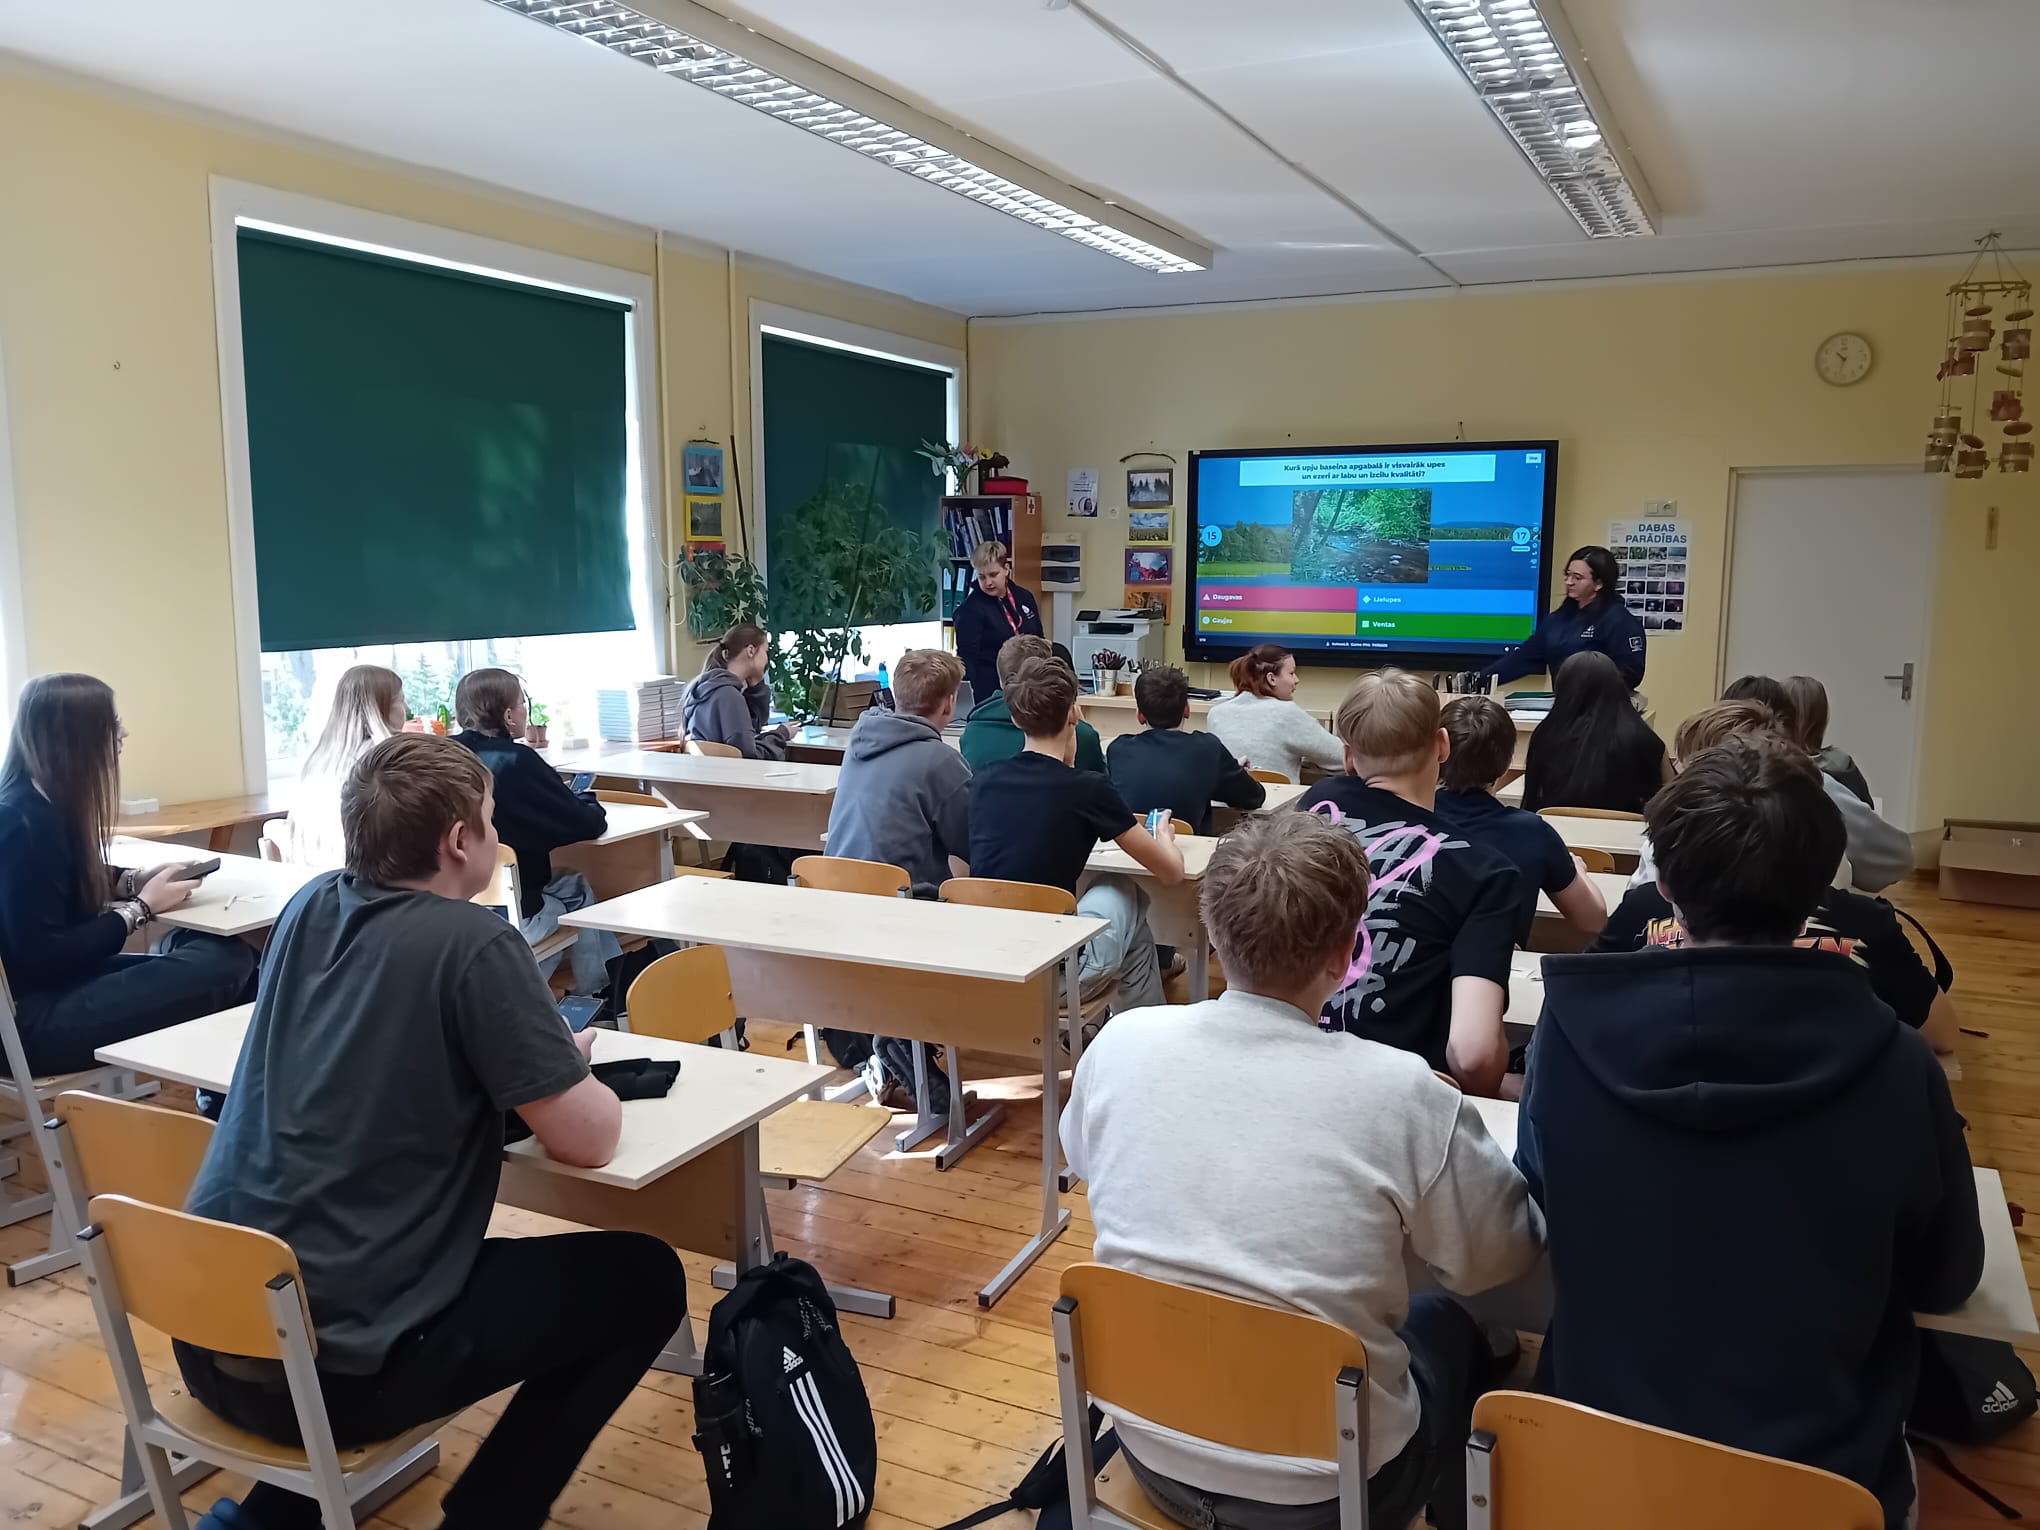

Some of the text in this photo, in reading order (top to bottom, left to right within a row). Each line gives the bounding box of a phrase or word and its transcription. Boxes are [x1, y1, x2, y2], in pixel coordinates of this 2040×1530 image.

[1284, 464, 1301, 472] Kurā
[1302, 463, 1318, 472] upju
[1349, 462, 1383, 471] apgabalā
[1392, 461, 1425, 469] visvairāk
[1427, 462, 1446, 470] upes
[1312, 472, 1331, 480] ezeri
[1369, 470, 1389, 478] izcilu
[1638, 523, 1675, 532] DABAS
[1207, 531, 1217, 540] 15
[1516, 531, 1527, 540] 17
[1625, 533, 1687, 543] PARĀDĪBAS
[1212, 593, 1243, 602] Daugavas
[1373, 596, 1401, 604] Lielupes
[1211, 616, 1233, 625] Gaujas
[1372, 620, 1396, 628] Ventas
